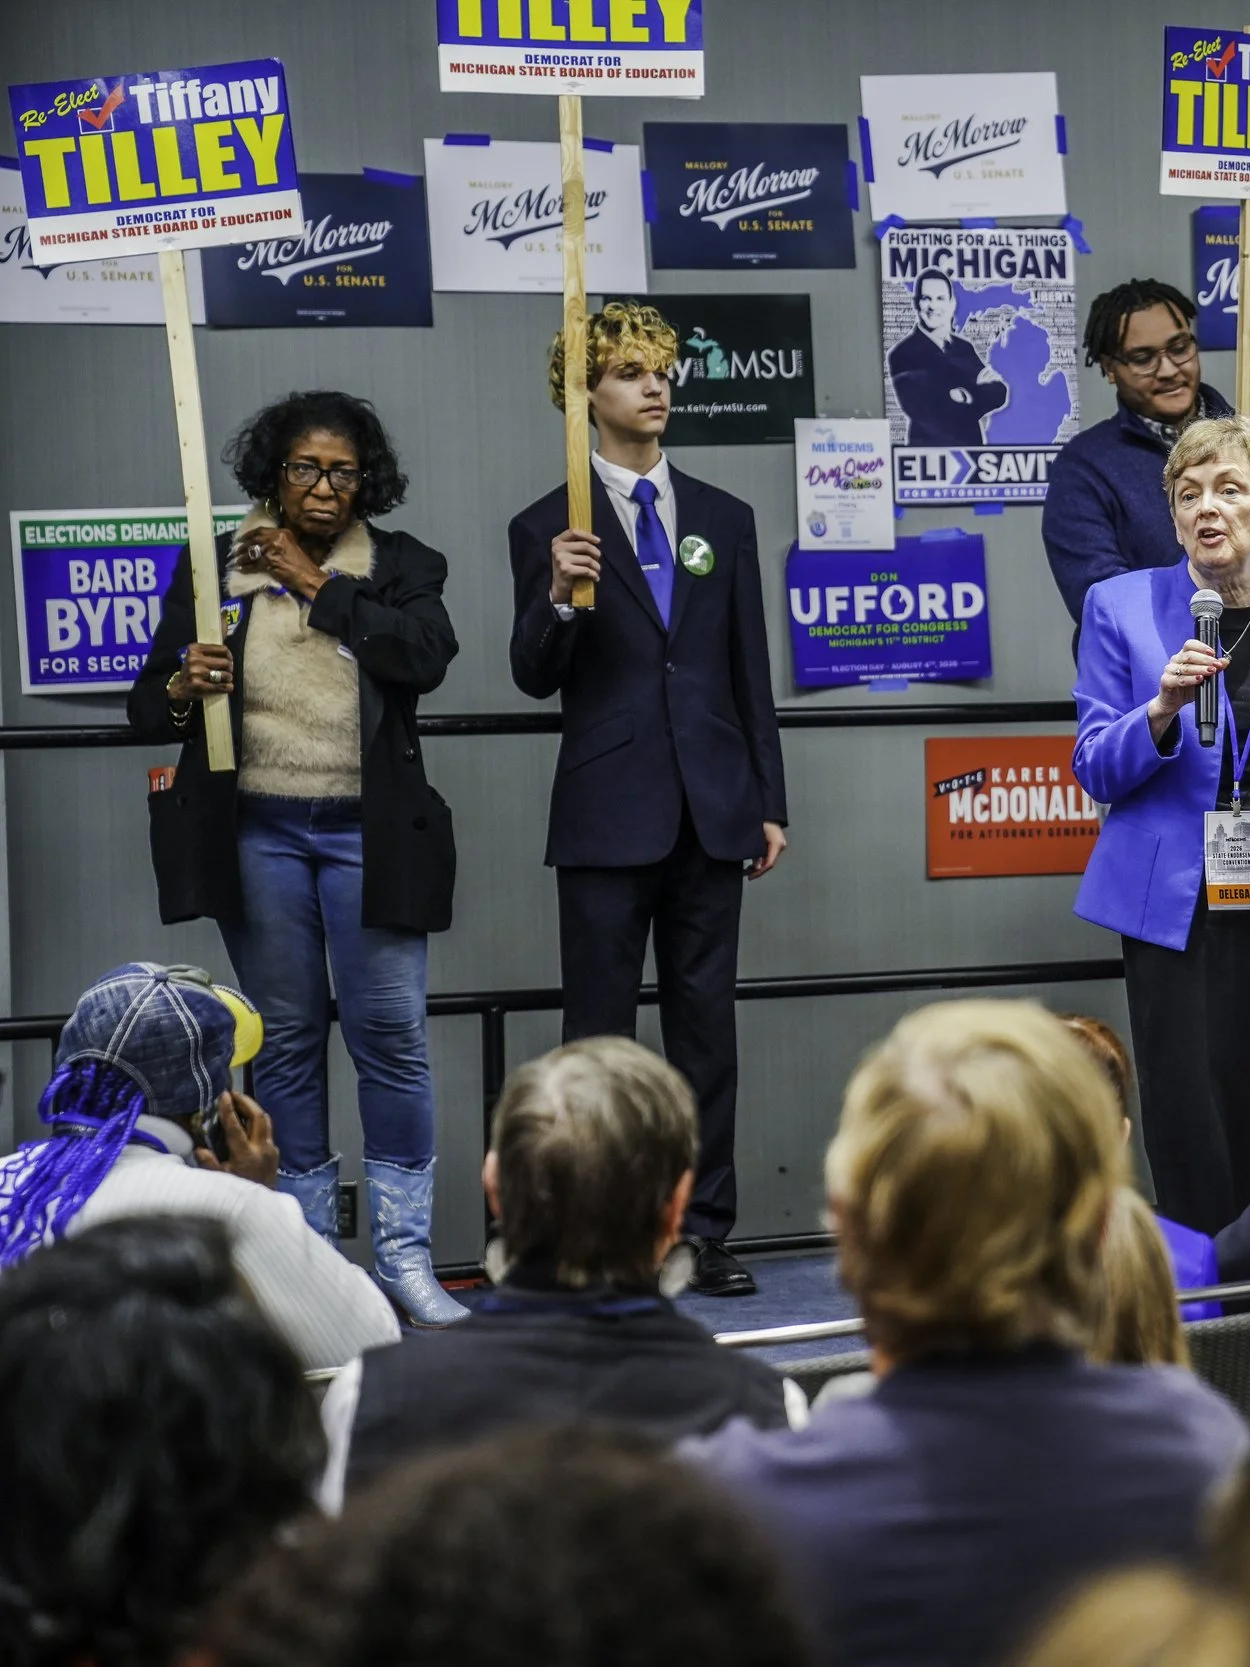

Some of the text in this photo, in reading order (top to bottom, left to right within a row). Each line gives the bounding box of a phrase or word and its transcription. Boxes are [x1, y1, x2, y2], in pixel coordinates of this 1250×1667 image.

[524, 54, 621, 66] DEMOCRAT FOR
[1170, 36, 1221, 71] Re-Elect
[450, 63, 695, 79] MICHIGAN STATE BOARD OF EDUCATION
[20, 84, 100, 131] Re-Elect
[129, 76, 278, 124] Tiffany
[897, 113, 1028, 167] McMorrow
[24, 114, 284, 208] TILLEY
[685, 161, 728, 170] MALLORY
[1169, 169, 1211, 180] MICHIGAN
[1214, 171, 1236, 181] STATE
[679, 161, 820, 217] McMorrow
[116, 207, 215, 226] DEMOCRAT FOR
[738, 221, 813, 231] U.S. SENATE
[40, 209, 292, 246] MICHIGAN STATE BOARD OF EDUCATION
[237, 214, 393, 270] McMorrow
[888, 232, 1067, 247] FIGHTING FOR ALL THINGS
[889, 247, 1066, 279] MICHIGAN
[101, 271, 154, 282] SENATE
[303, 275, 386, 287] U.S. SENATE
[731, 349, 797, 379] MSU
[898, 455, 946, 481] ELI
[904, 488, 1048, 498] FOR ATTORNEY GENER
[25, 522, 117, 544] ELECTIONS
[69, 558, 157, 594] BARB
[870, 573, 898, 582] DON
[789, 582, 985, 625] UFFORD
[45, 595, 162, 653] BYR
[809, 620, 968, 637] DEMOCRAT FOR CONGRESS
[902, 635, 945, 645] DISTRICT
[39, 657, 80, 675] FOR
[992, 766, 1060, 783] KAREN
[949, 785, 1098, 824] McDONALD
[979, 829, 1042, 839] ATTORNEY
